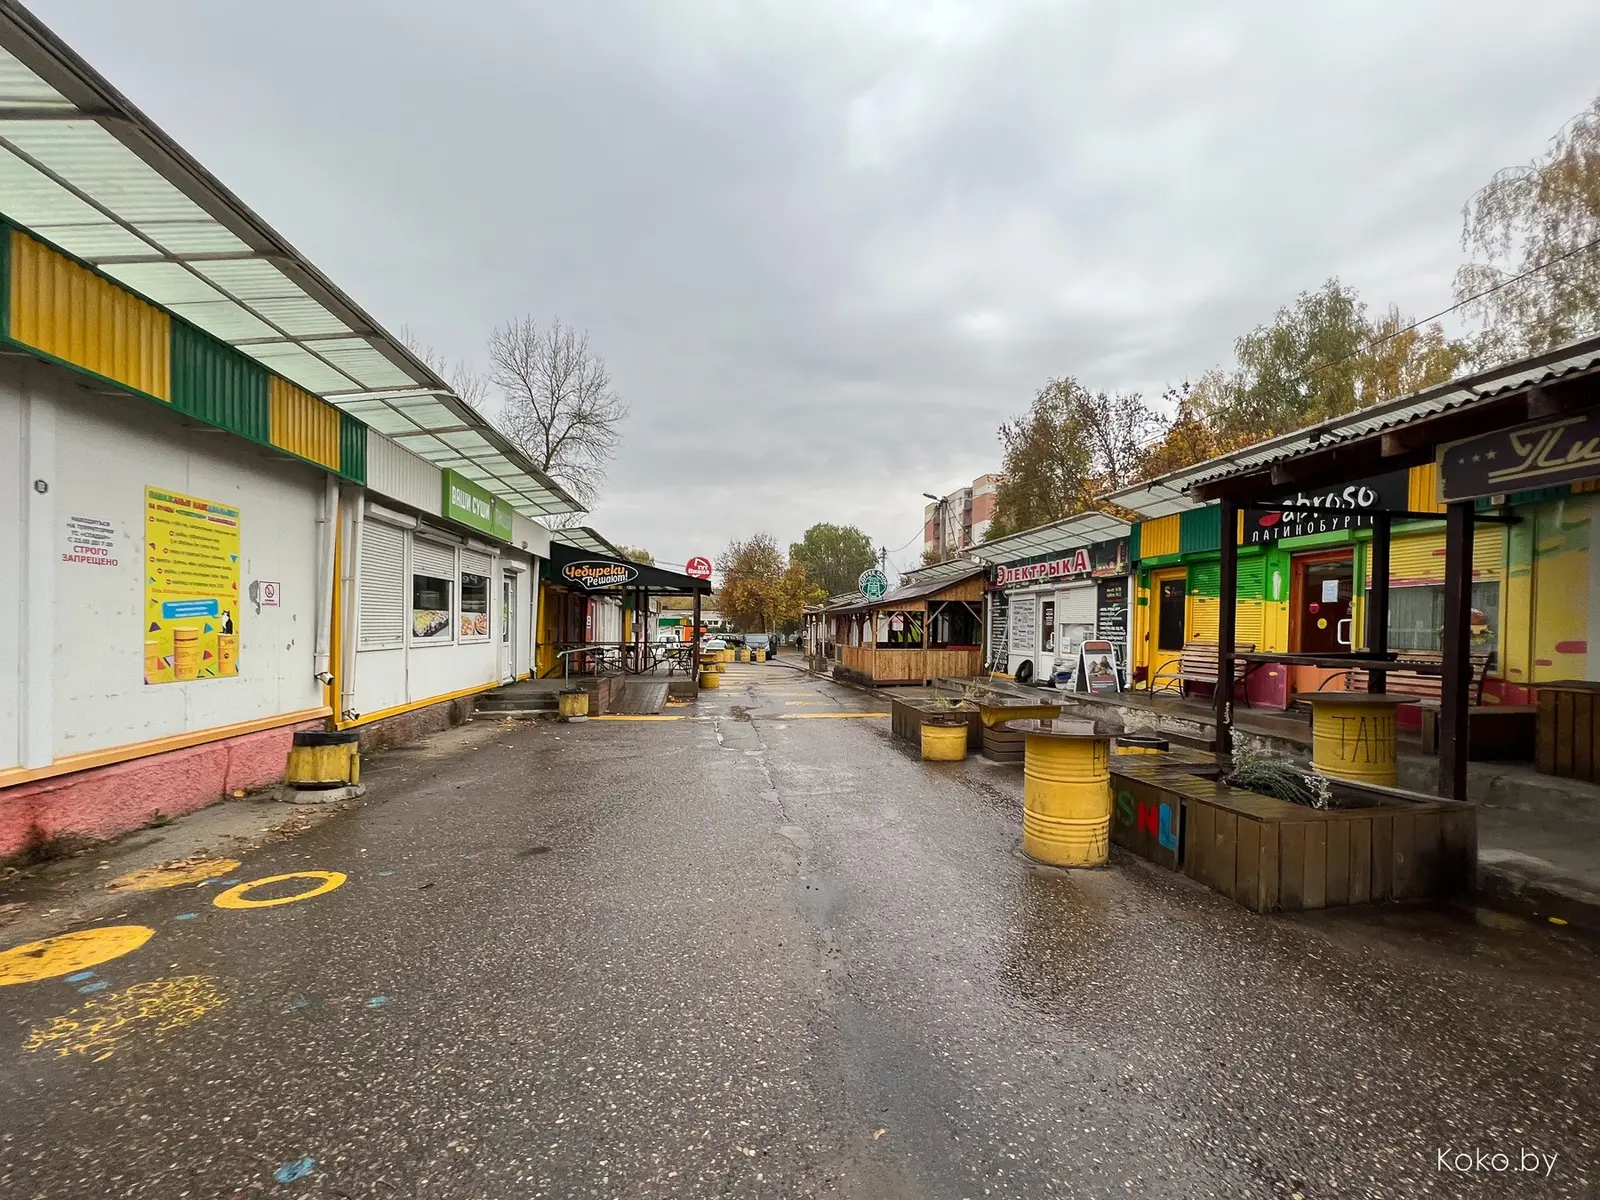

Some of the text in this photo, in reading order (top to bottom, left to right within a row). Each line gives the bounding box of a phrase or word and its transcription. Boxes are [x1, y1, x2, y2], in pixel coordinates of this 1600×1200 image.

[451, 485, 471, 512] ВАШИ
[472, 496, 490, 521] СУШИ
[73, 545, 108, 556] СТРОГО
[62, 553, 119, 567] ЗАПРЕЩЕНО
[565, 564, 625, 578] Чебуреки
[582, 570, 628, 587] Решают!
